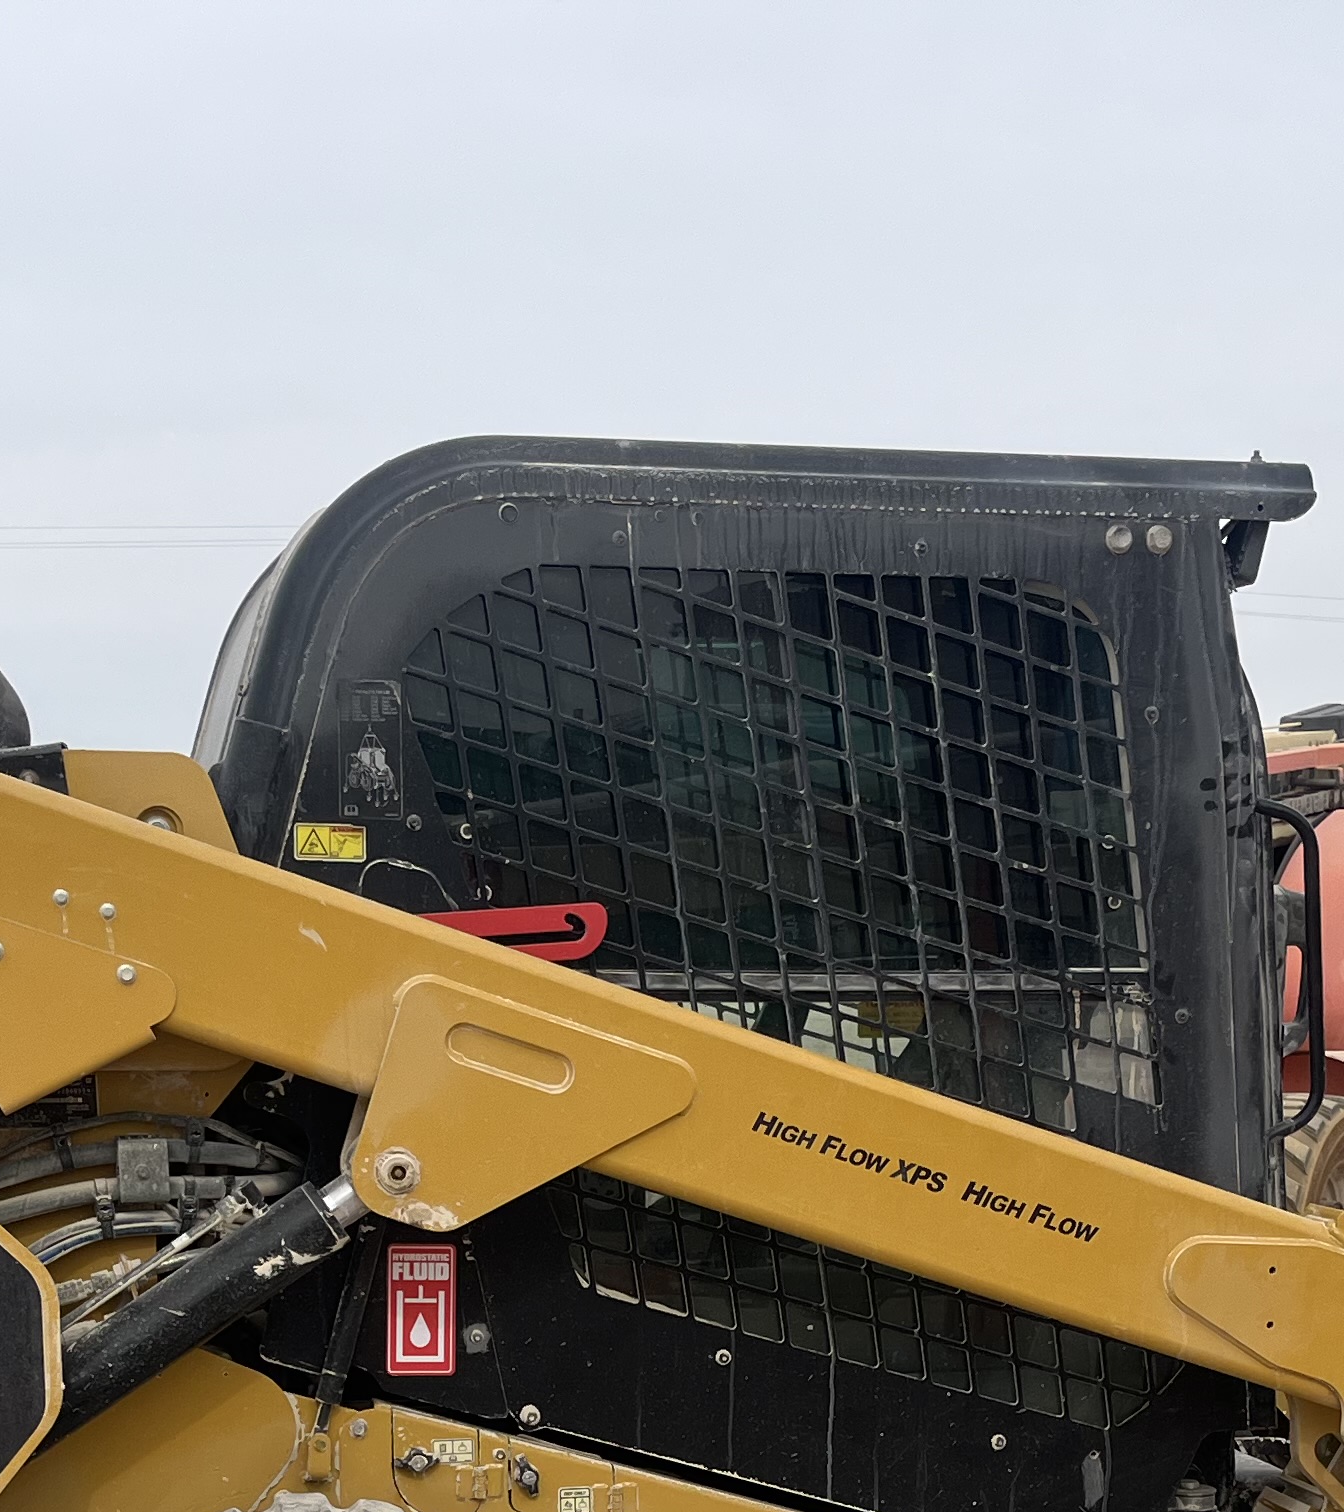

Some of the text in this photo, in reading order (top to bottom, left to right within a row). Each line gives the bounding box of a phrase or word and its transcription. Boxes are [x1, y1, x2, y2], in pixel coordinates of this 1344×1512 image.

[752, 1111, 1100, 1243] HIGH FLOW XPS HIGH FLOW
[392, 1262, 450, 1281] FLUID
